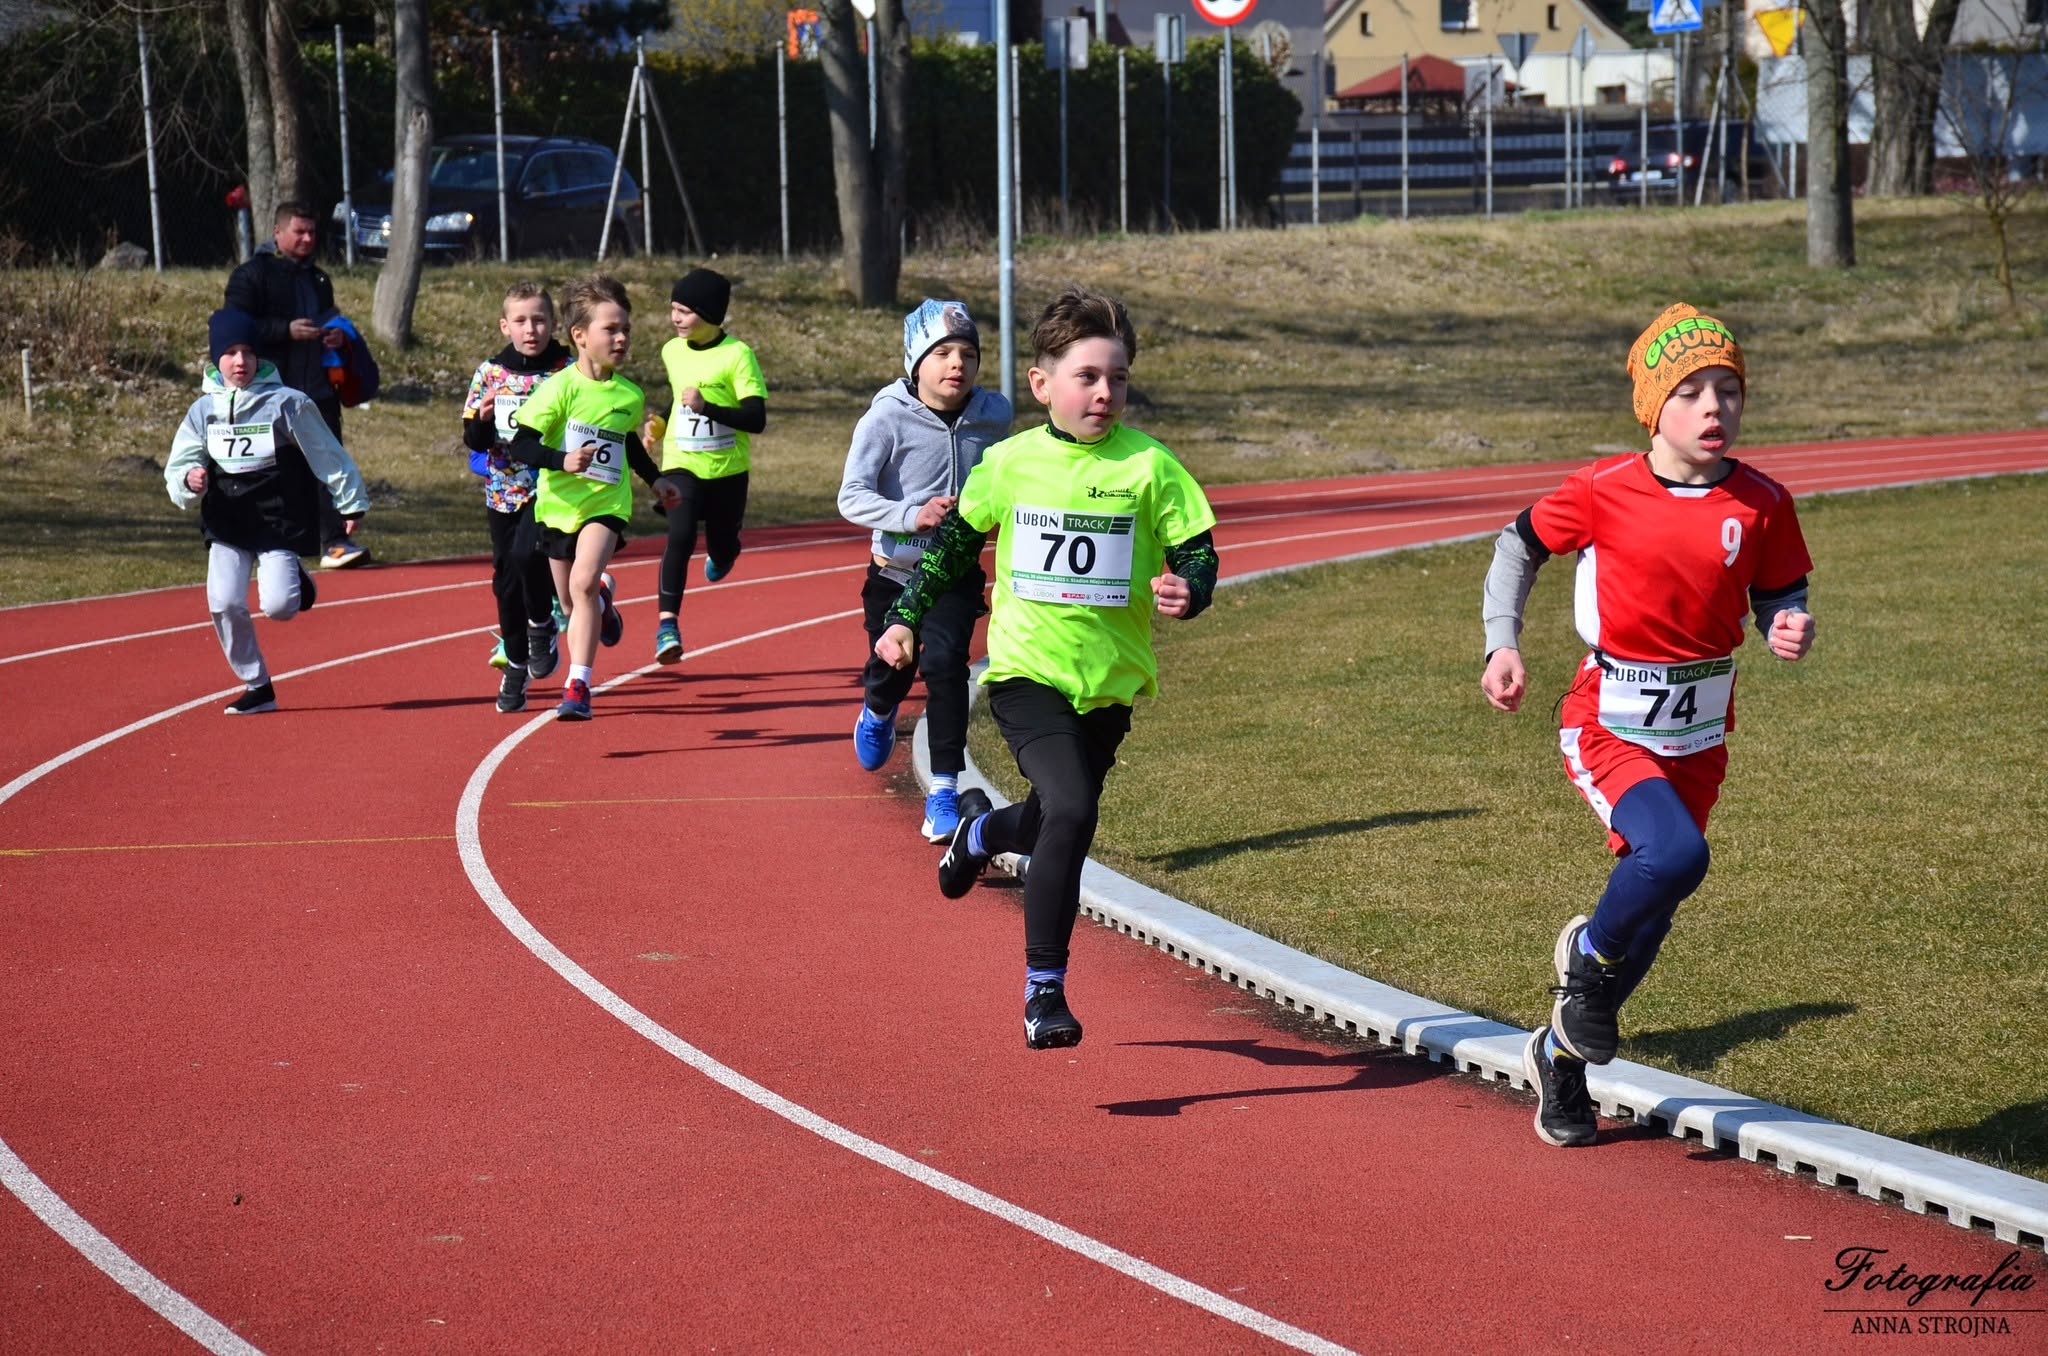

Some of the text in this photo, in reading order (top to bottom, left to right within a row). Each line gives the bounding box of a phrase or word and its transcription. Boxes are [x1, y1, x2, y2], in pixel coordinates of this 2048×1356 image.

[1645, 318, 1736, 369] GREEN
[1662, 329, 1725, 363] RUN
[234, 427, 256, 435] TRACK
[688, 418, 714, 437] 71
[223, 436, 254, 458] 72
[1016, 510, 1105, 529] LUBOŃ TRACK
[1040, 532, 1096, 576] 70
[1721, 517, 1743, 567] 9
[1671, 666, 1706, 680] TRACK
[1640, 685, 1697, 727] 74
